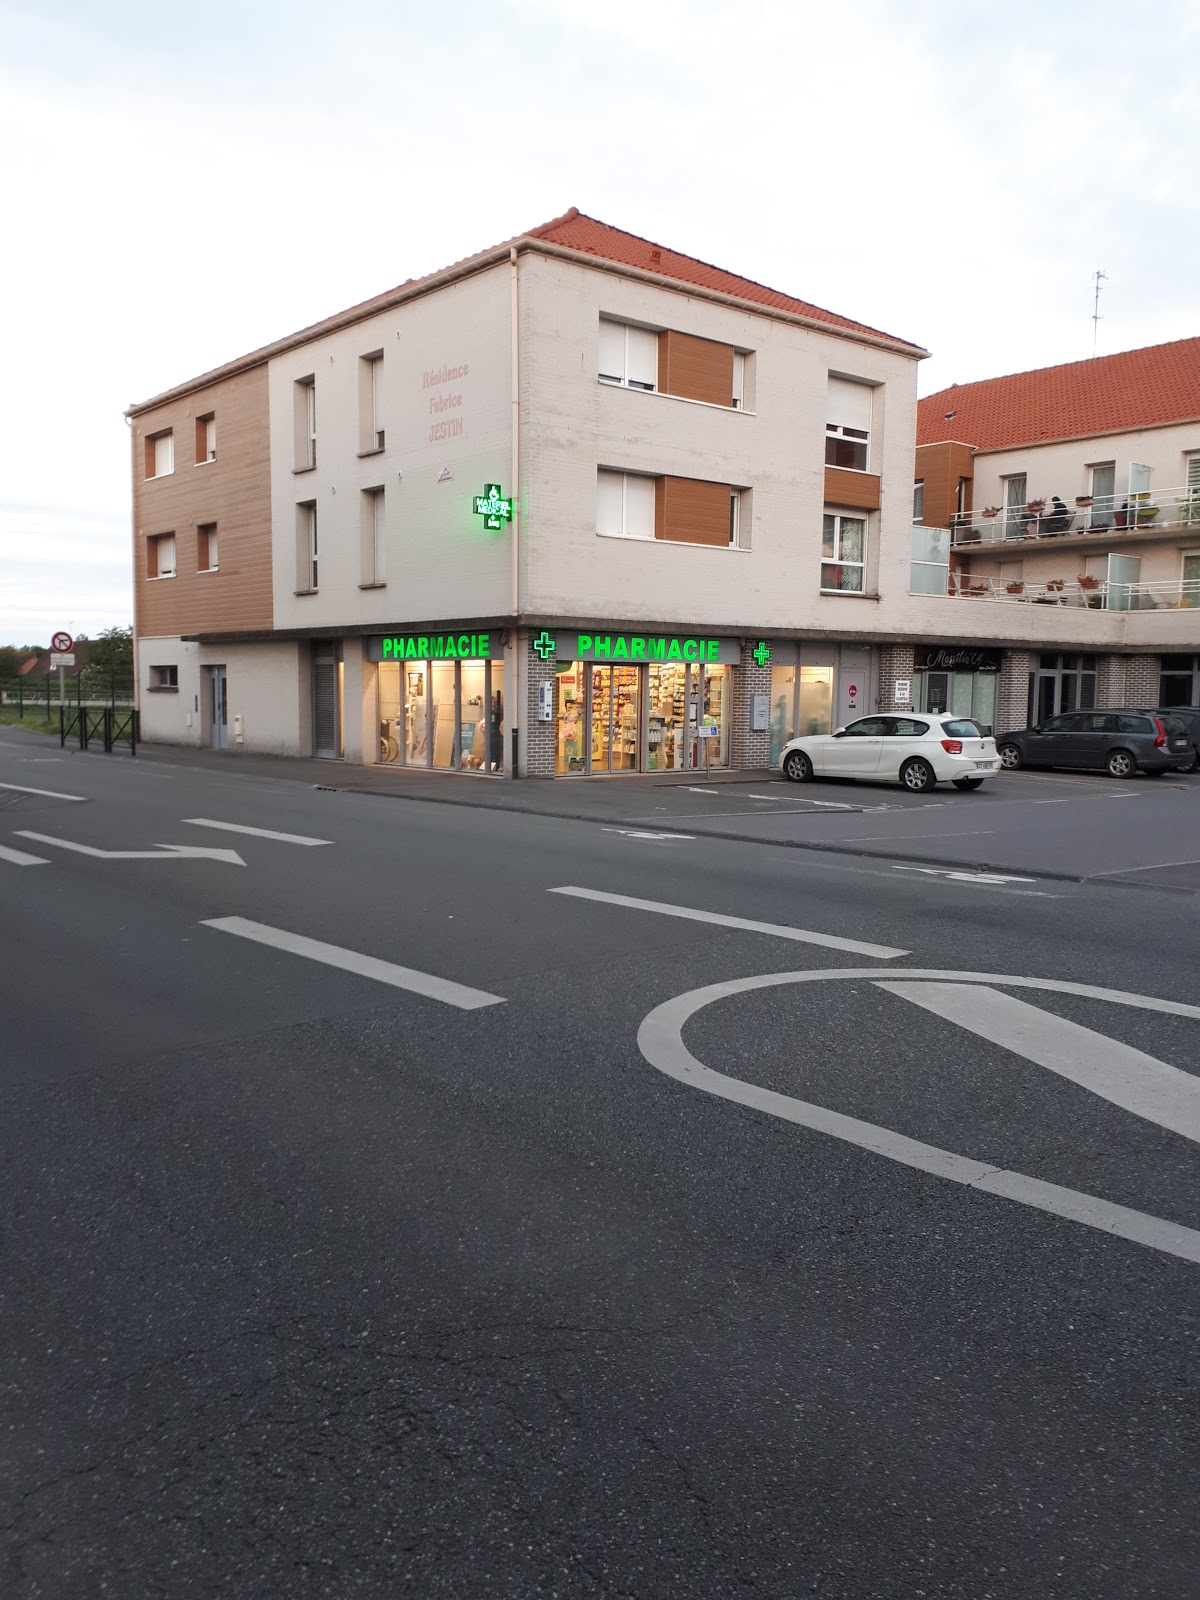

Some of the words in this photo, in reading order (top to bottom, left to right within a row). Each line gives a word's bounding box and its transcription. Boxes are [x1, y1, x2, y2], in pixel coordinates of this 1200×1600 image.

[424, 364, 468, 388] Résidence
[429, 394, 462, 413] Fabrice
[430, 418, 463, 442] JESTIN
[382, 634, 490, 659] PHARMACIE
[577, 635, 721, 661] PHARMACIE
